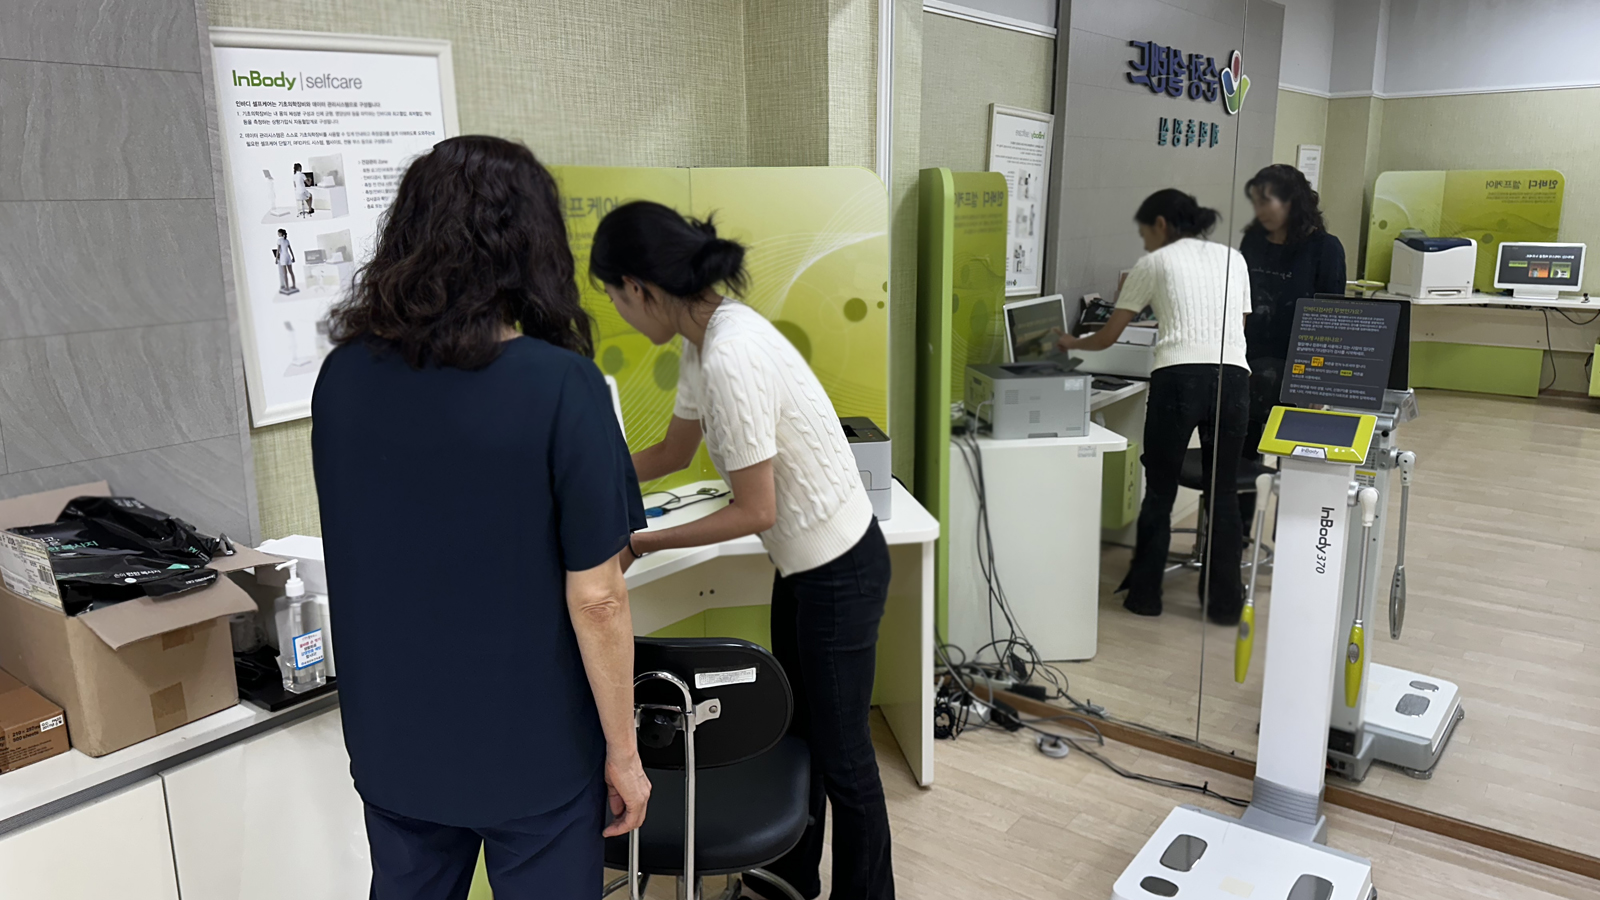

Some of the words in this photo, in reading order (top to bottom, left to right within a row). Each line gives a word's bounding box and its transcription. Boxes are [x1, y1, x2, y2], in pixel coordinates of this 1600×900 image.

[232, 69, 296, 91] InBody
[305, 73, 363, 90] selfcare
[1315, 506, 1335, 554] InBody
[1315, 554, 1327, 574] 370
